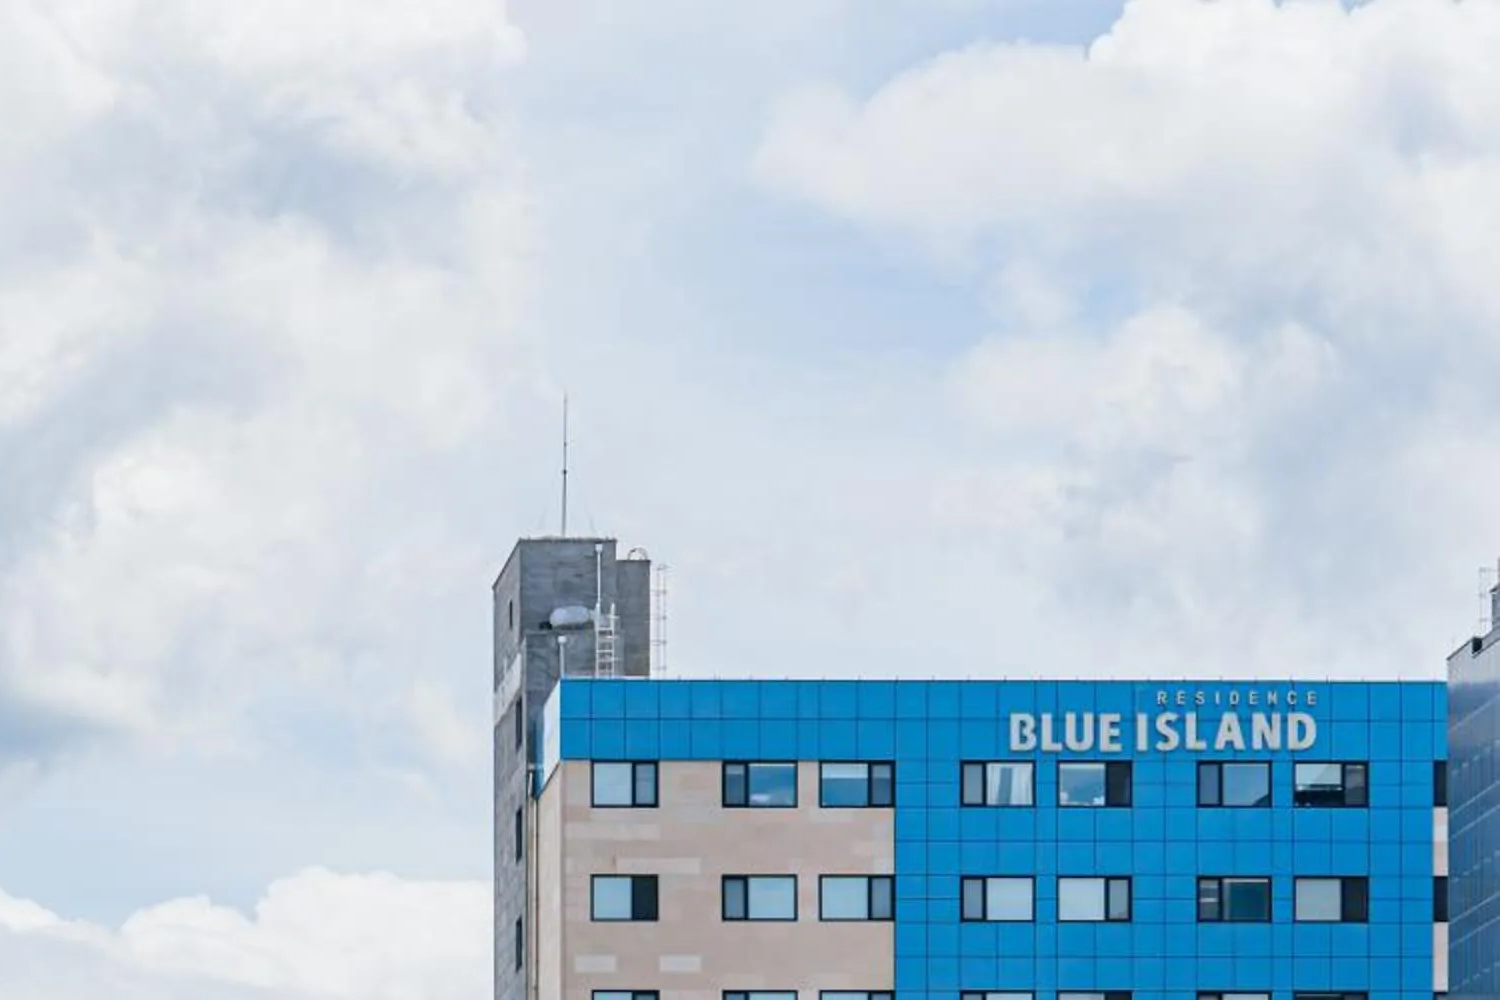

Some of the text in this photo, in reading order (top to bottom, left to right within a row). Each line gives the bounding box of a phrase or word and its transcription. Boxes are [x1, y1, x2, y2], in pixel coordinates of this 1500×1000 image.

[1156, 690, 1319, 706] RESIDENCE
[1009, 711, 1318, 752] BLUE ISLAND
